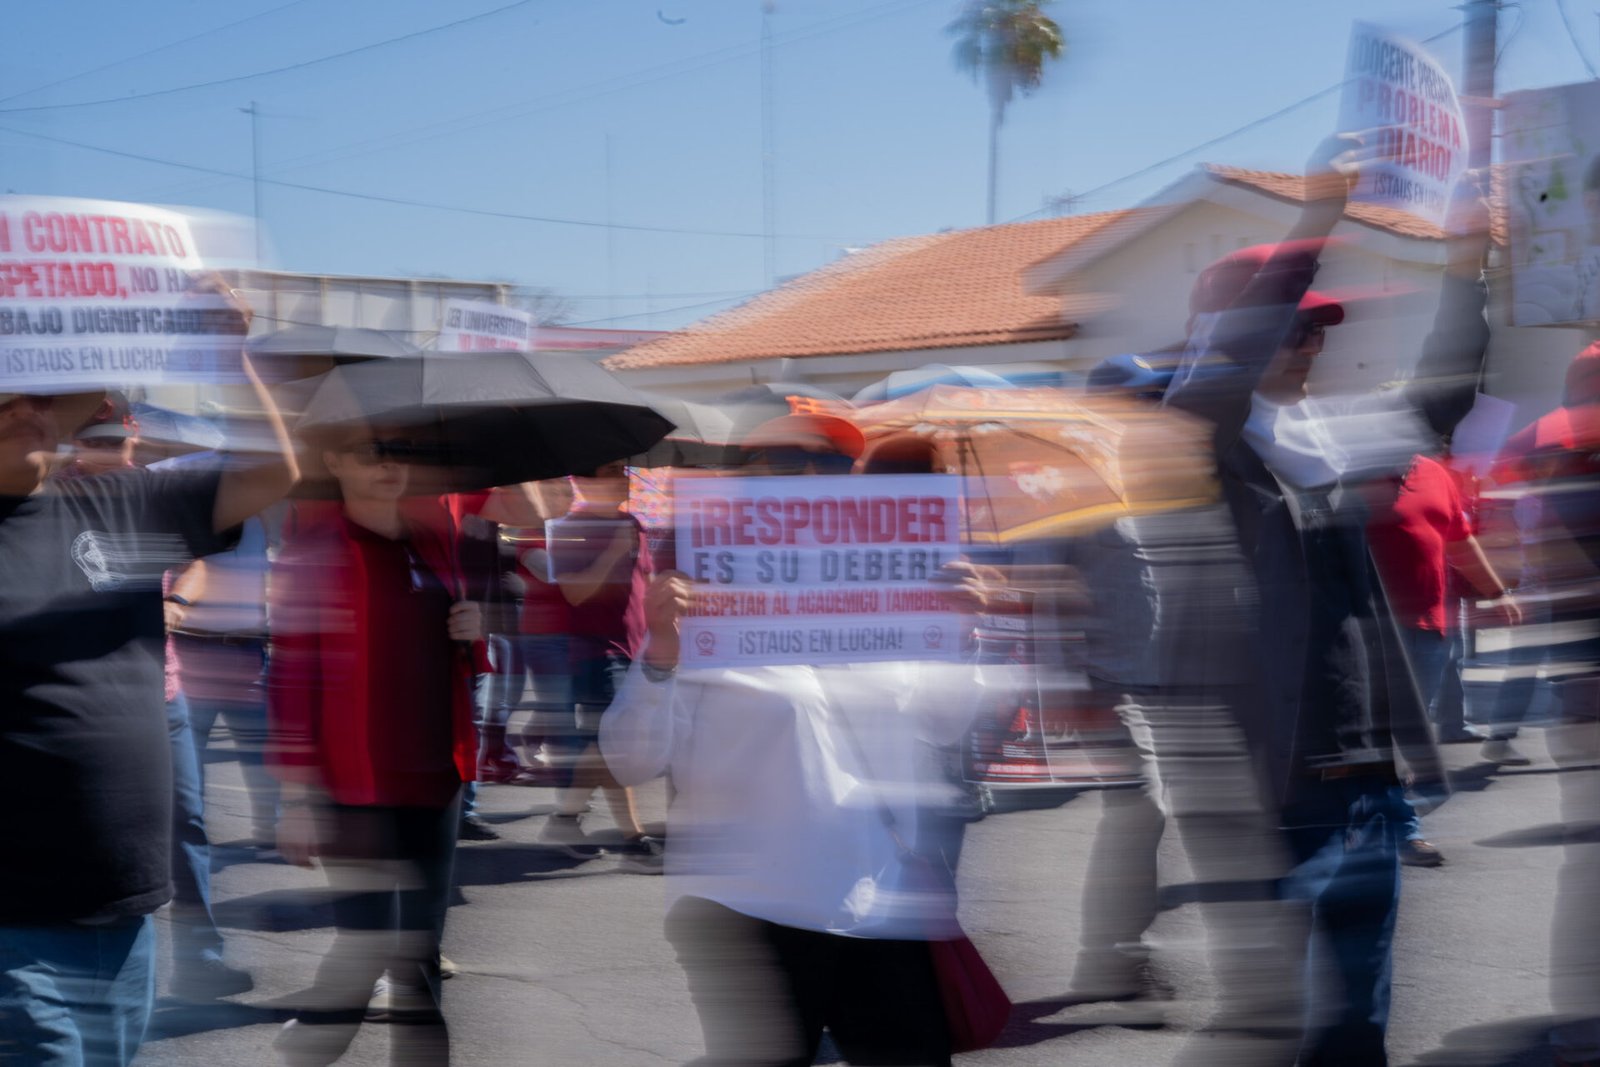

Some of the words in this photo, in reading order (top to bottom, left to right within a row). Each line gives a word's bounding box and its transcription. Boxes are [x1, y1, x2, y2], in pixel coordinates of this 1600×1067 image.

[1357, 80, 1461, 150] PROBLEMA
[23, 210, 187, 258] CONTRATO
[129, 266, 159, 293] NO
[80, 346, 104, 371] EN
[690, 494, 946, 548] ¡RESPONDER
[694, 551, 735, 584] ES
[756, 549, 800, 584] SU
[820, 547, 942, 582] DEBER!
[772, 590, 790, 616] AL
[738, 629, 804, 656] ¡STAUS
[809, 629, 832, 653] EN
[838, 626, 903, 653] LUCHA!
